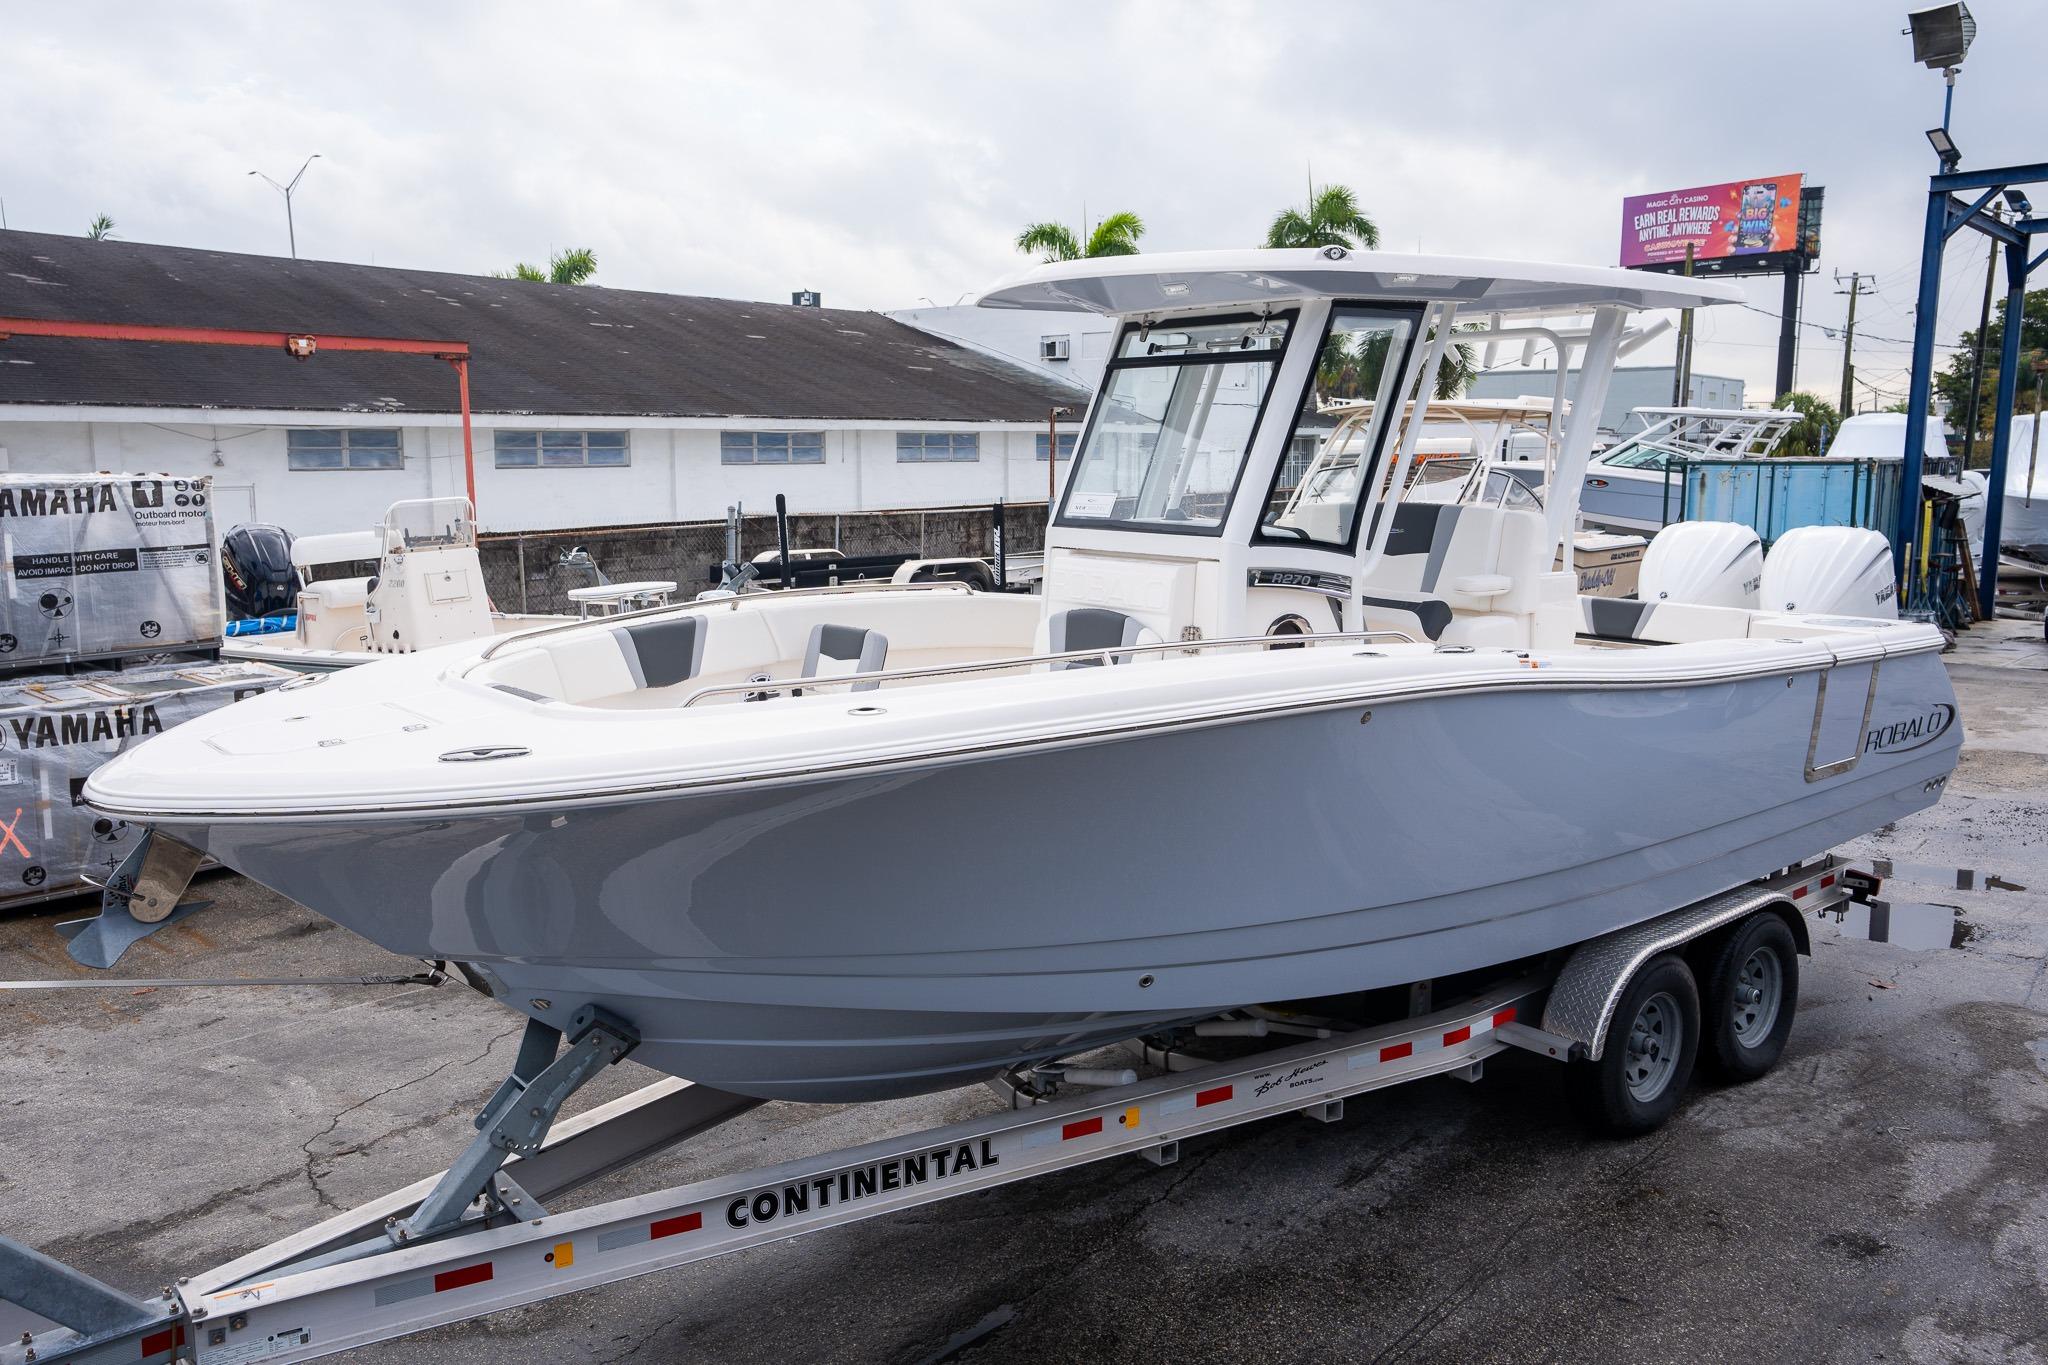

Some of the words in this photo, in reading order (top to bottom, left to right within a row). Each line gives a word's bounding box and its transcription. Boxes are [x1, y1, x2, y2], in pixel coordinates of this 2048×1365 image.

[1646, 199, 1668, 208] MAGIC
[1684, 194, 1709, 203] CASINO
[1634, 213, 1656, 230] EARN
[1657, 209, 1678, 225] REAL
[1679, 205, 1721, 222] REWARDS
[1745, 207, 1768, 220] BIG
[1639, 225, 1671, 242] ANYTIME,
[1672, 222, 1712, 236] ANYWHERE.
[1742, 220, 1768, 234] WIN
[0, 484, 118, 517] AMAHA
[134, 510, 177, 519] Outboard
[178, 510, 206, 518] motor
[32, 556, 69, 565] HANDLE
[71, 554, 92, 562] WITH
[94, 552, 118, 560] CARE
[17, 568, 44, 577] AVOID
[93, 563, 110, 571] NOT
[112, 561, 136, 570] DROP
[1272, 573, 1311, 585] R270
[9, 705, 163, 750] YAMAHA
[1864, 712, 1942, 754] ROBALO
[1254, 1076, 1284, 1097] Bob
[725, 1138, 1000, 1229] CONTINENTAL
